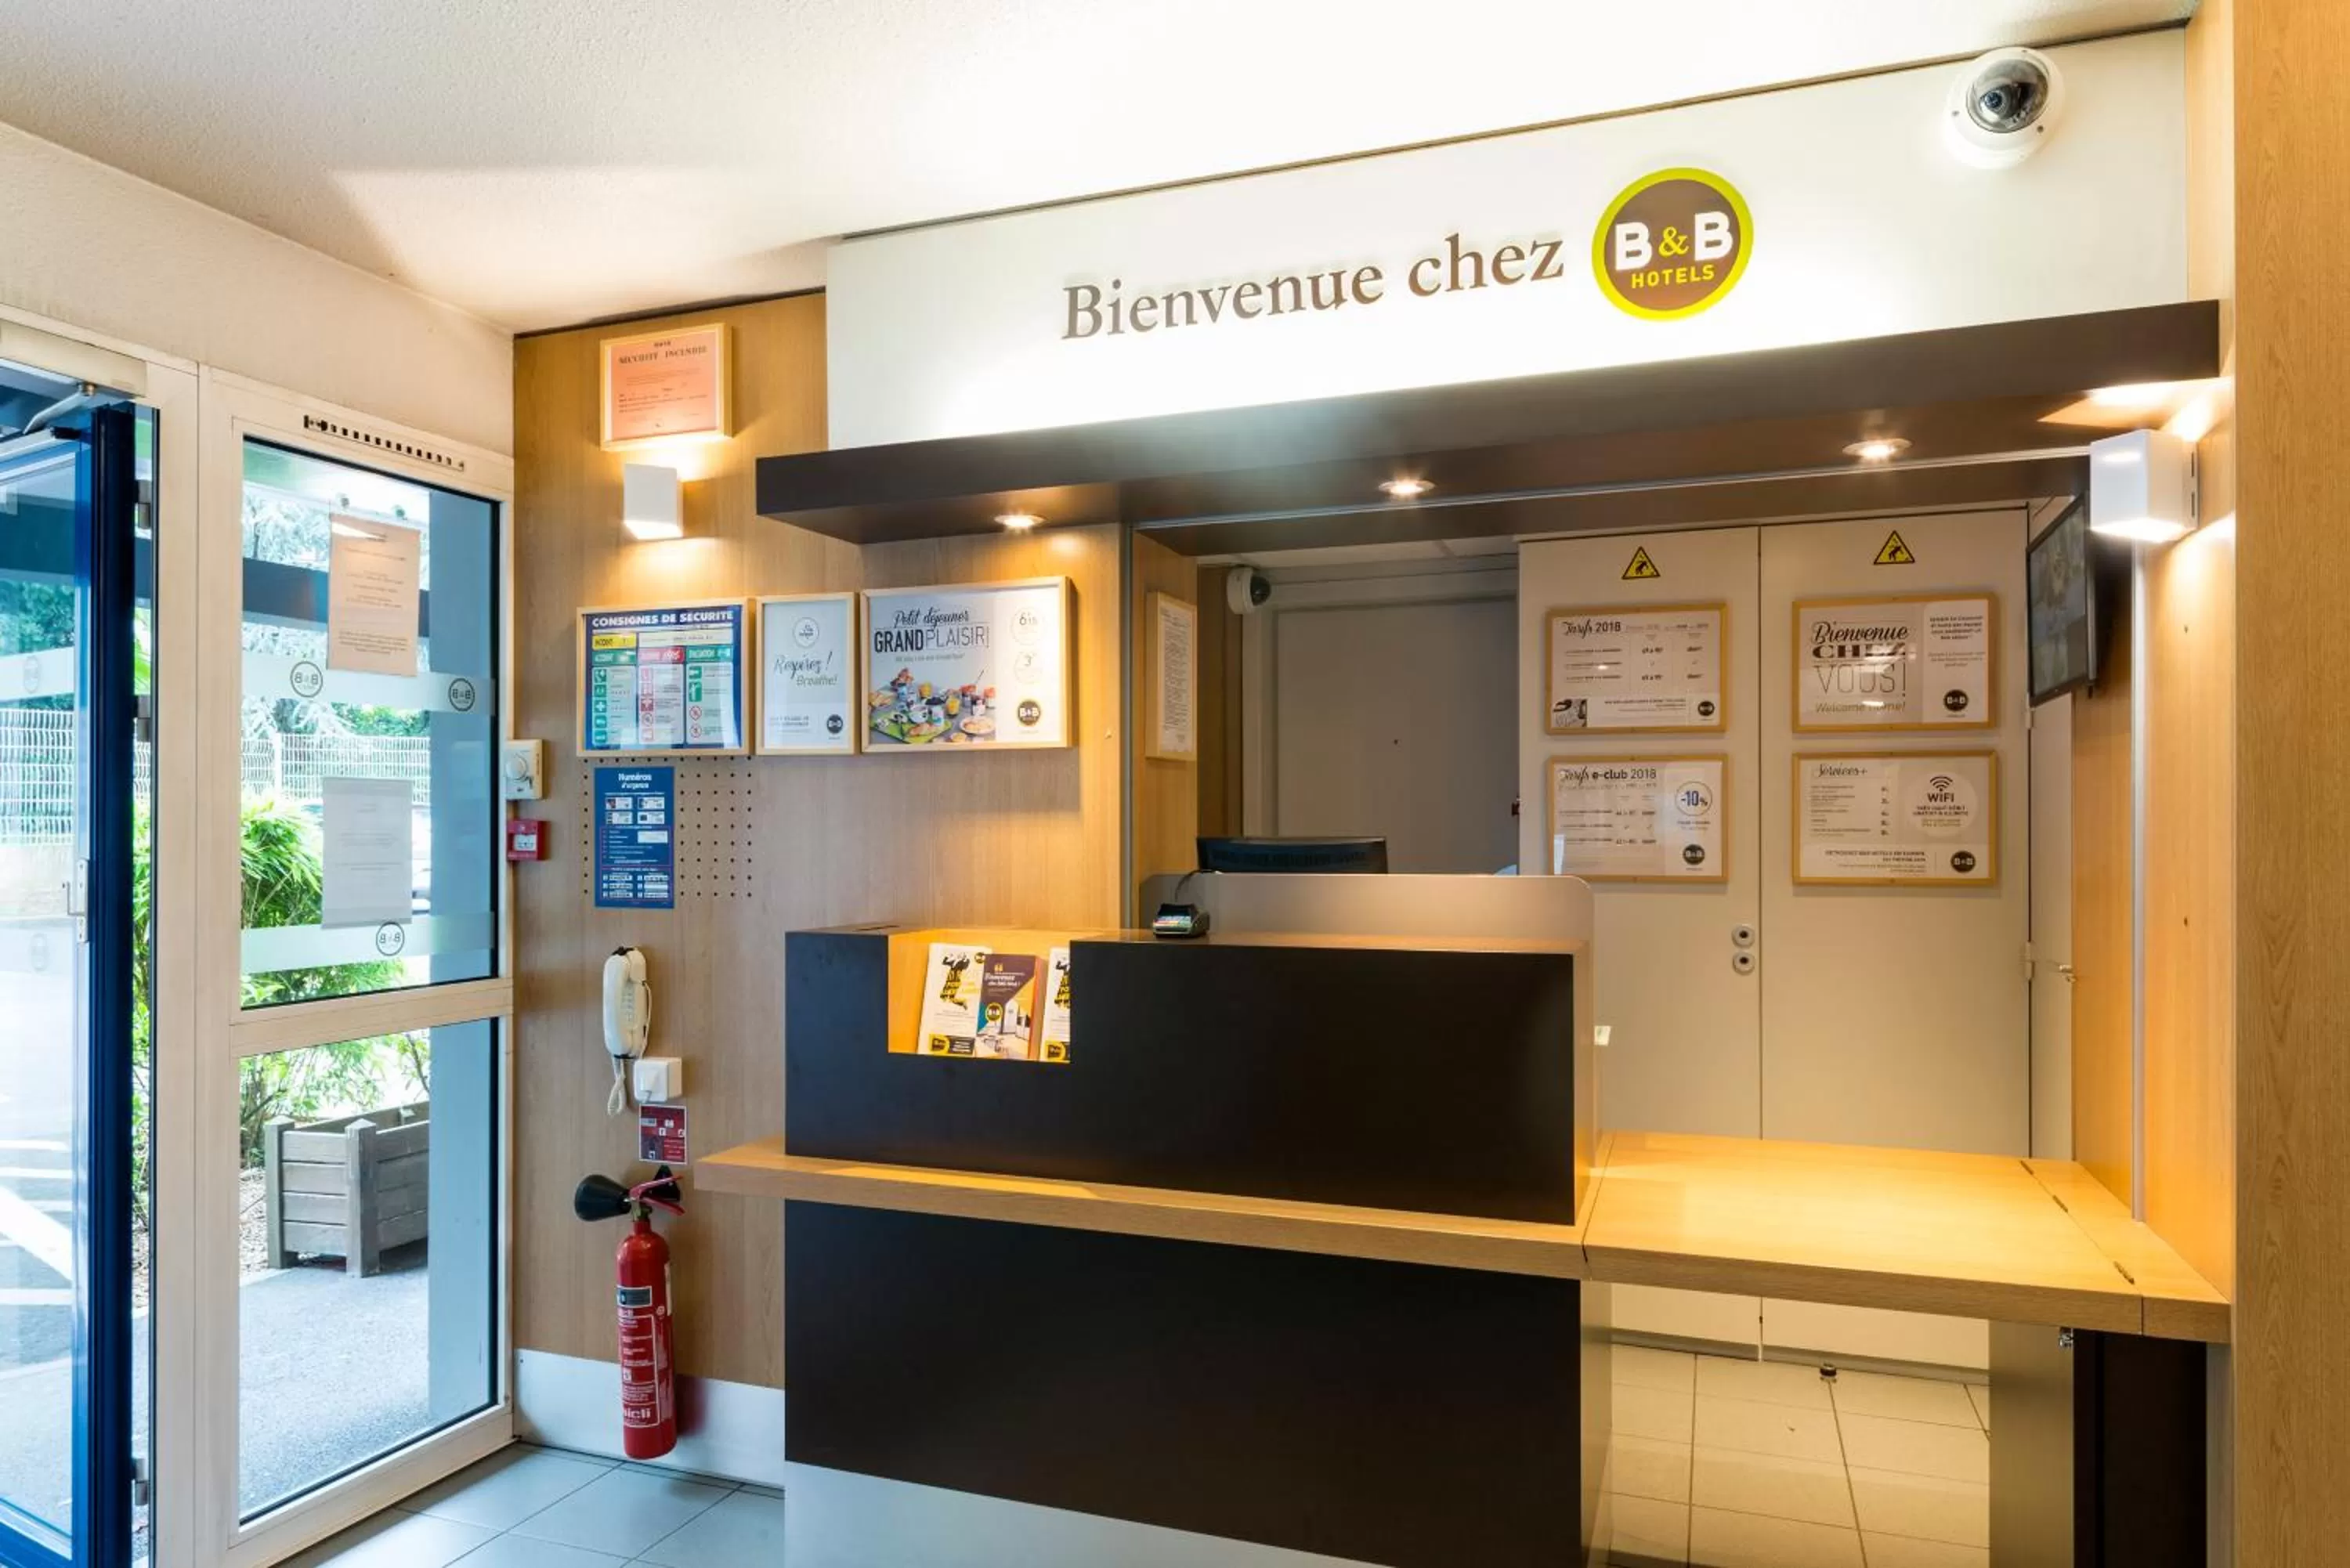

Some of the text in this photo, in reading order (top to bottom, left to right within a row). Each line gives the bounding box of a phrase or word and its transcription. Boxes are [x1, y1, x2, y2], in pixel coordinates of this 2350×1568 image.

[1062, 233, 1564, 340] Bienvenue chez
[1631, 265, 1715, 289] HOTELS
[592, 616, 658, 627] CONSIGNES
[661, 613, 676, 623] DE
[894, 607, 920, 628] Petit
[1596, 621, 1621, 632] 2018
[874, 629, 924, 652] GRAND
[1812, 620, 1909, 645] Bienvenue
[1813, 641, 1906, 658] CHEZ
[1592, 768, 1628, 780] e-club
[1631, 768, 1657, 780] 2018
